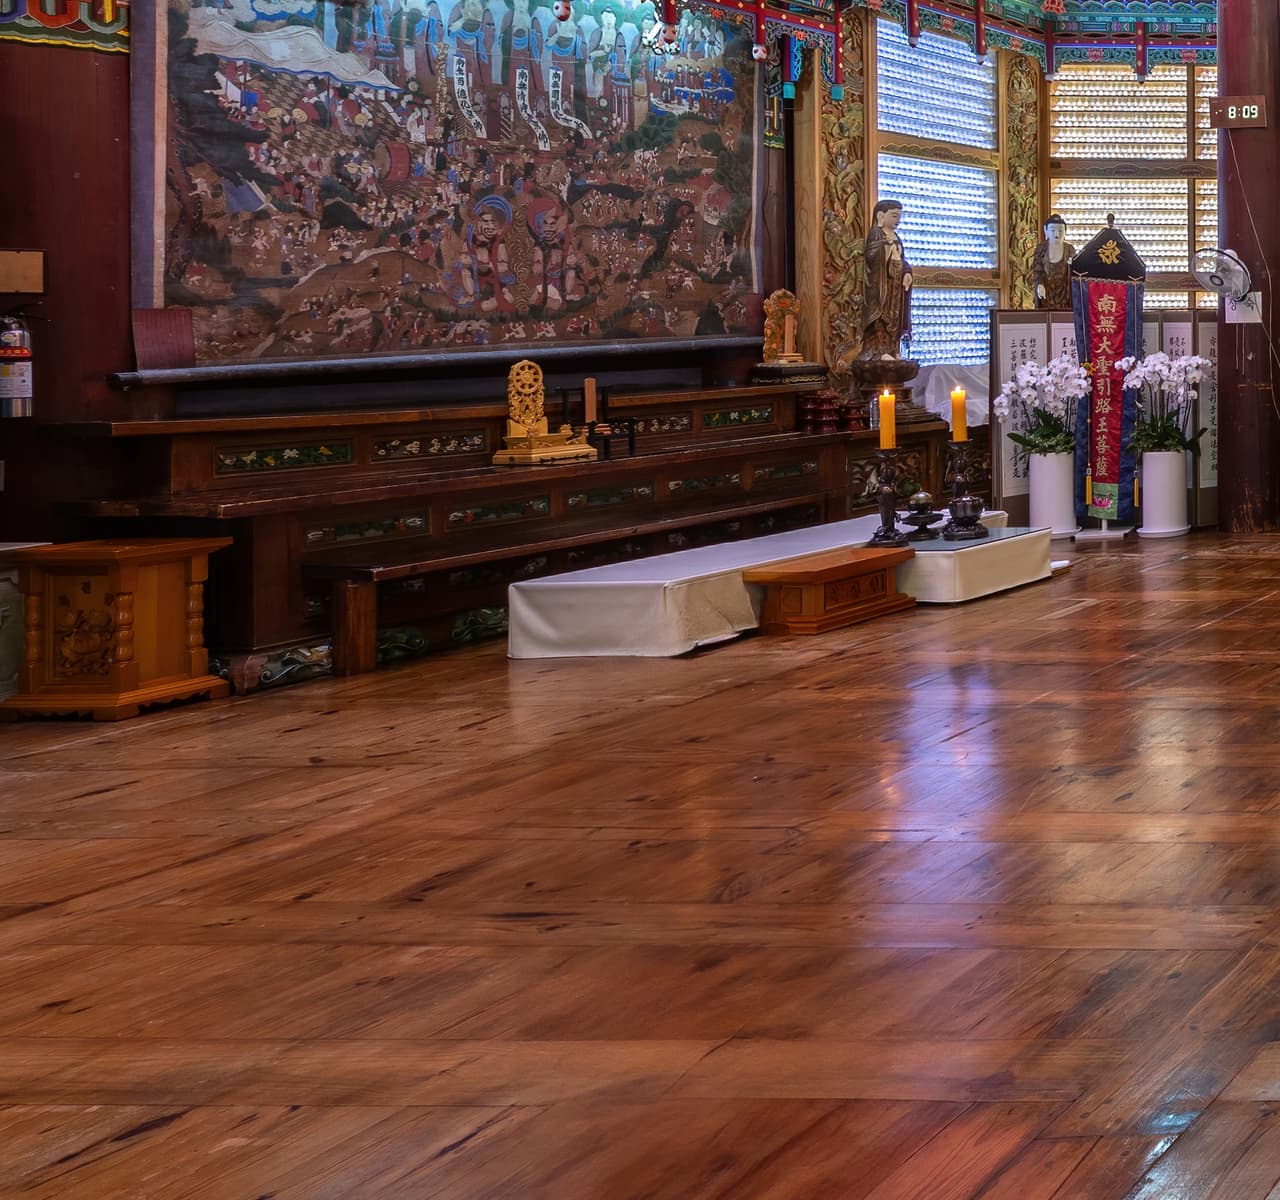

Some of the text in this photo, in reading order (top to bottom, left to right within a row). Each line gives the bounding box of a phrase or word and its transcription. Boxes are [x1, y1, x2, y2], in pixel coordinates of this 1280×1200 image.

[1228, 105, 1258, 119] 8:09
[1096, 294, 1116, 477] 南無大聖引路王菩薩
